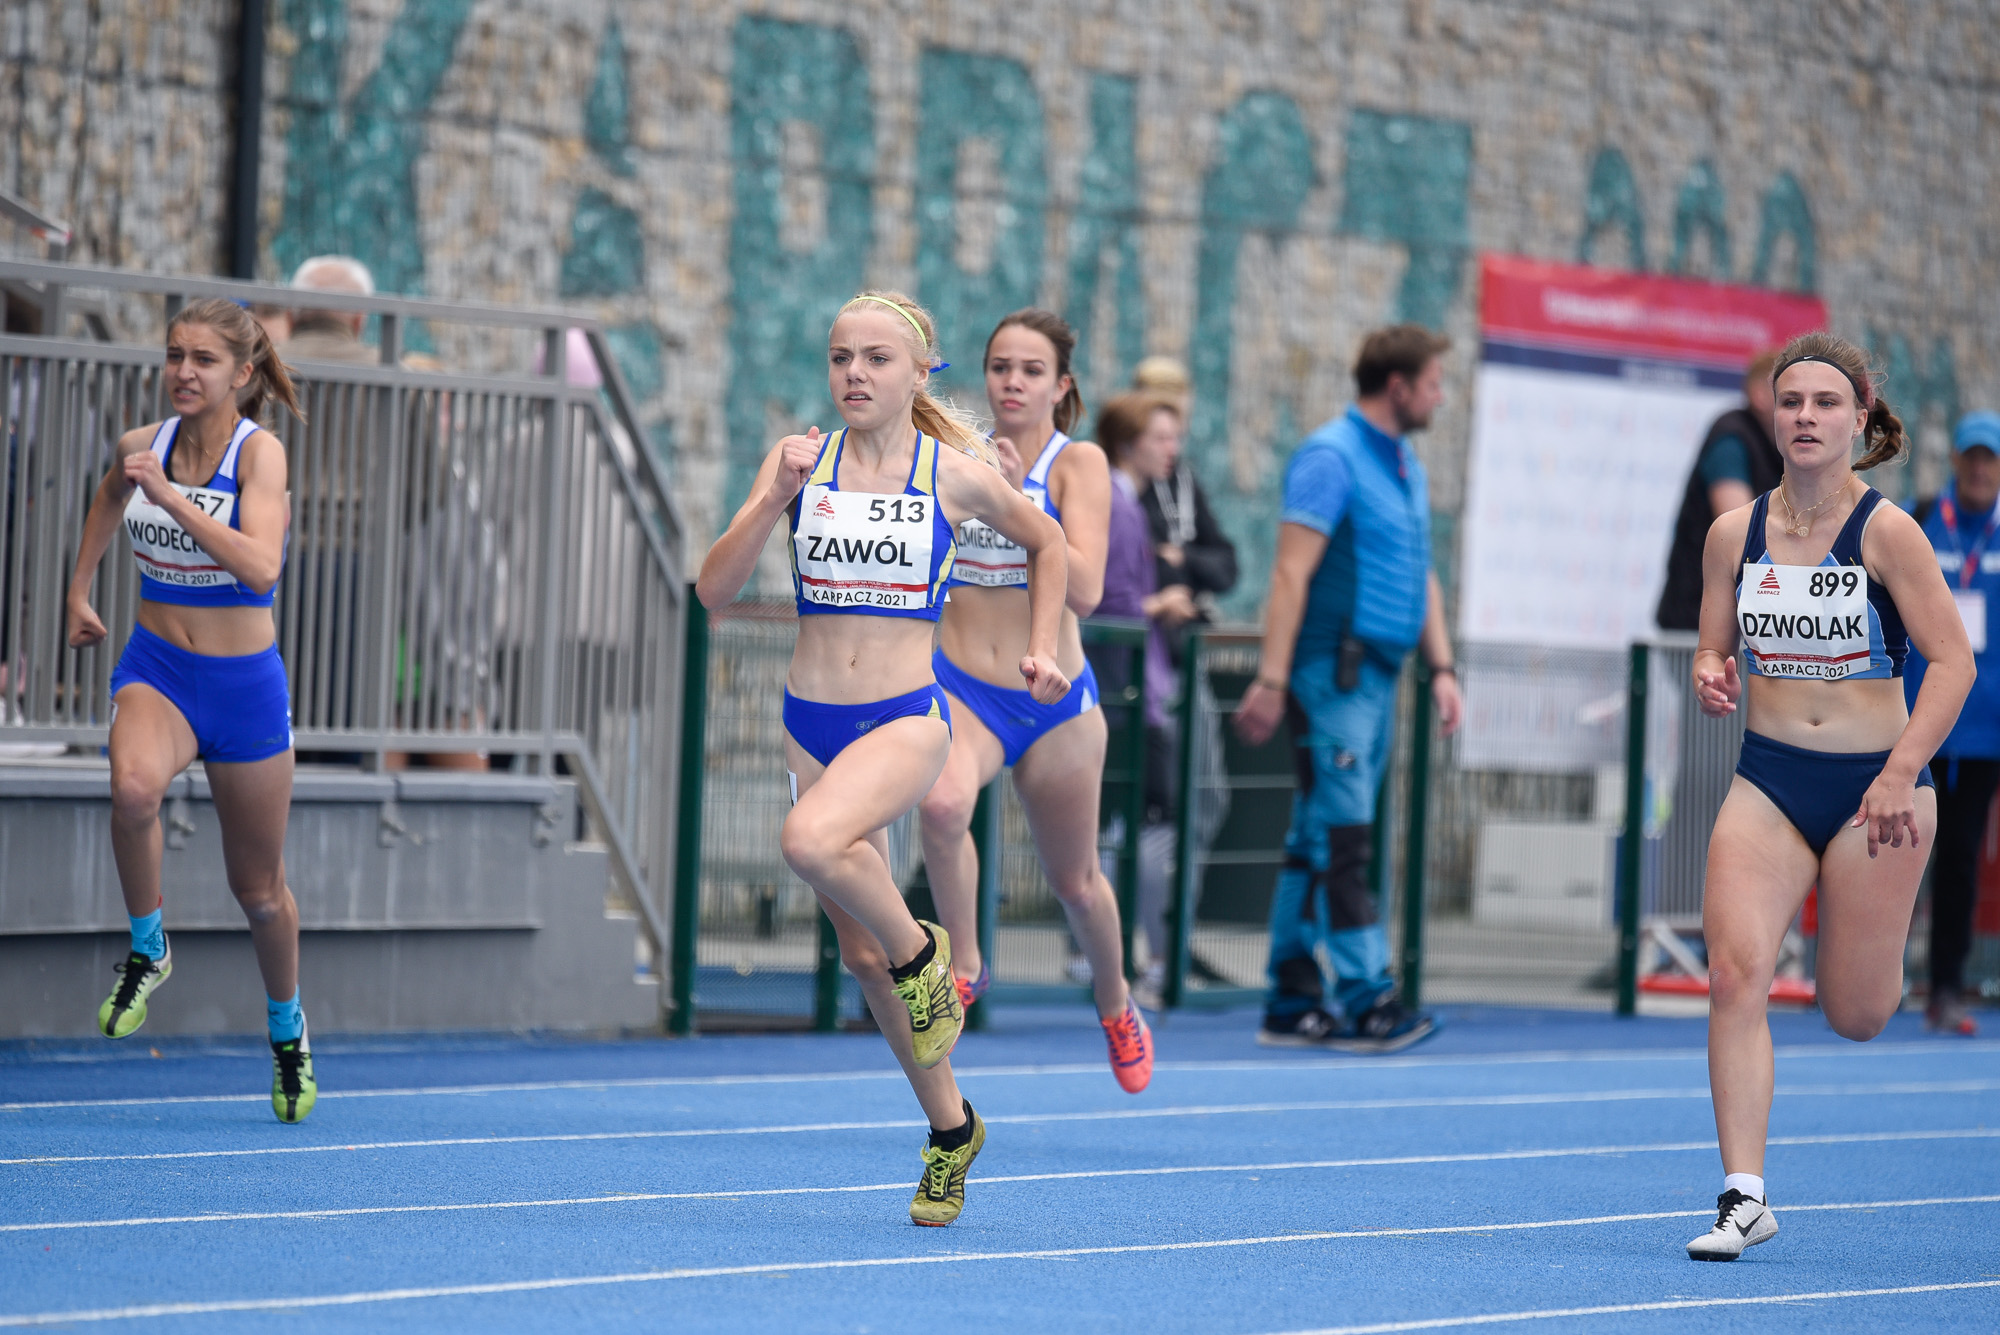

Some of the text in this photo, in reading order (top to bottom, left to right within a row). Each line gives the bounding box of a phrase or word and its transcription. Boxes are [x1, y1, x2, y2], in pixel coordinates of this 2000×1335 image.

[186, 492, 225, 517] 57
[868, 499, 925, 523] 513
[807, 535, 913, 567] ZAWÓL
[145, 565, 218, 585] KARPACZ 2021
[1000, 571, 1026, 584] 2021
[1809, 571, 1859, 597] 899
[812, 589, 907, 606] KARPACZ 2021
[1742, 612, 1864, 640] DZWOLAK
[1762, 663, 1850, 678] KARPACZ 2021
